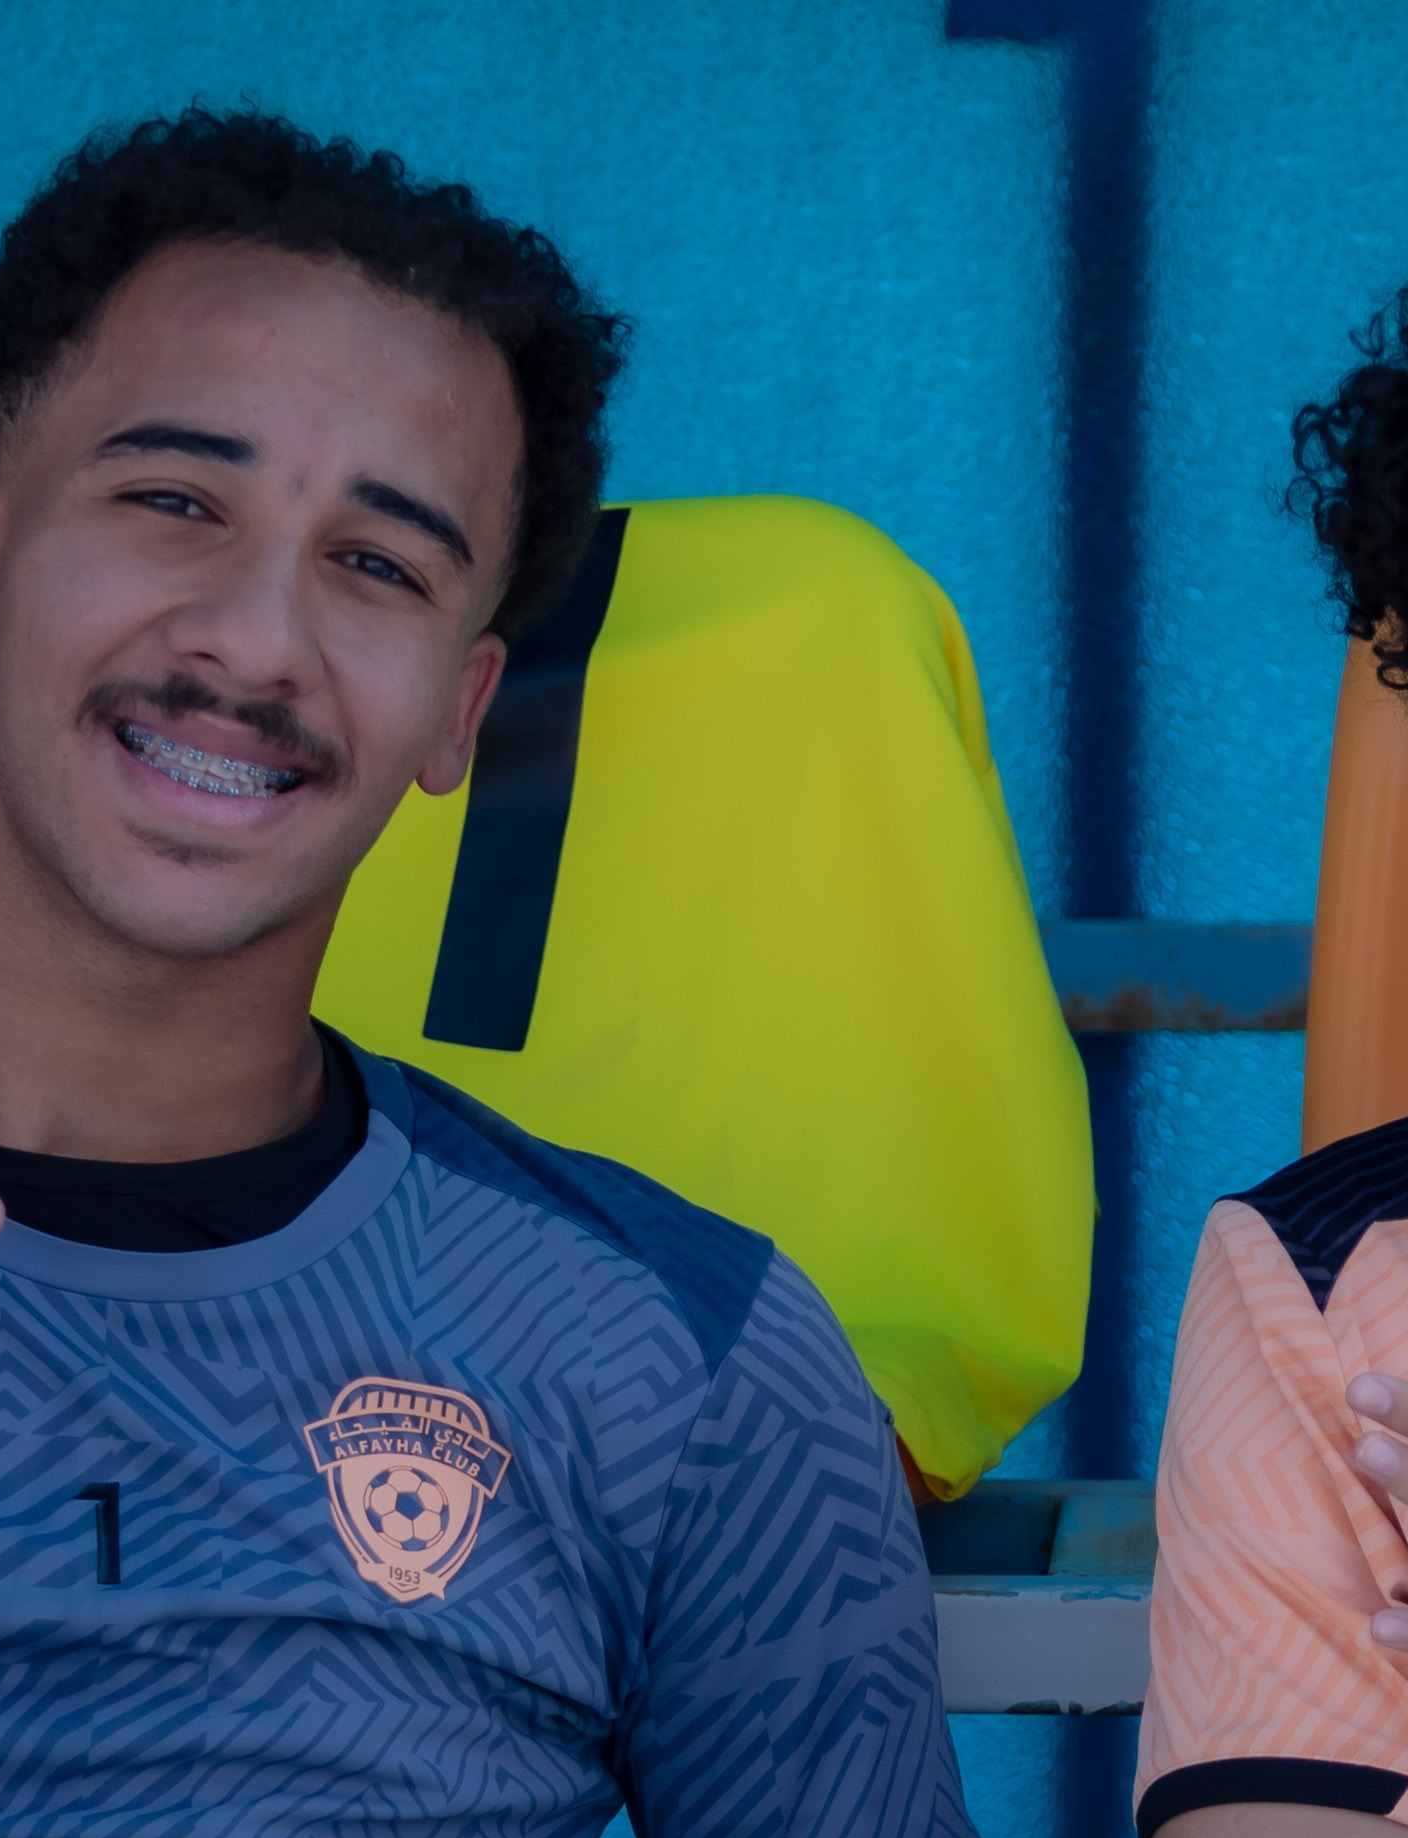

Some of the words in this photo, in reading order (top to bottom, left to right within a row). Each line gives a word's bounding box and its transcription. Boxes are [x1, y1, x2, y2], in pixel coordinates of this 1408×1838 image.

[334, 1438, 424, 1460] ALFAYHA
[430, 1447, 482, 1479] CLUB
[71, 1481, 122, 1585] 1
[388, 1565, 422, 1586] 1953
